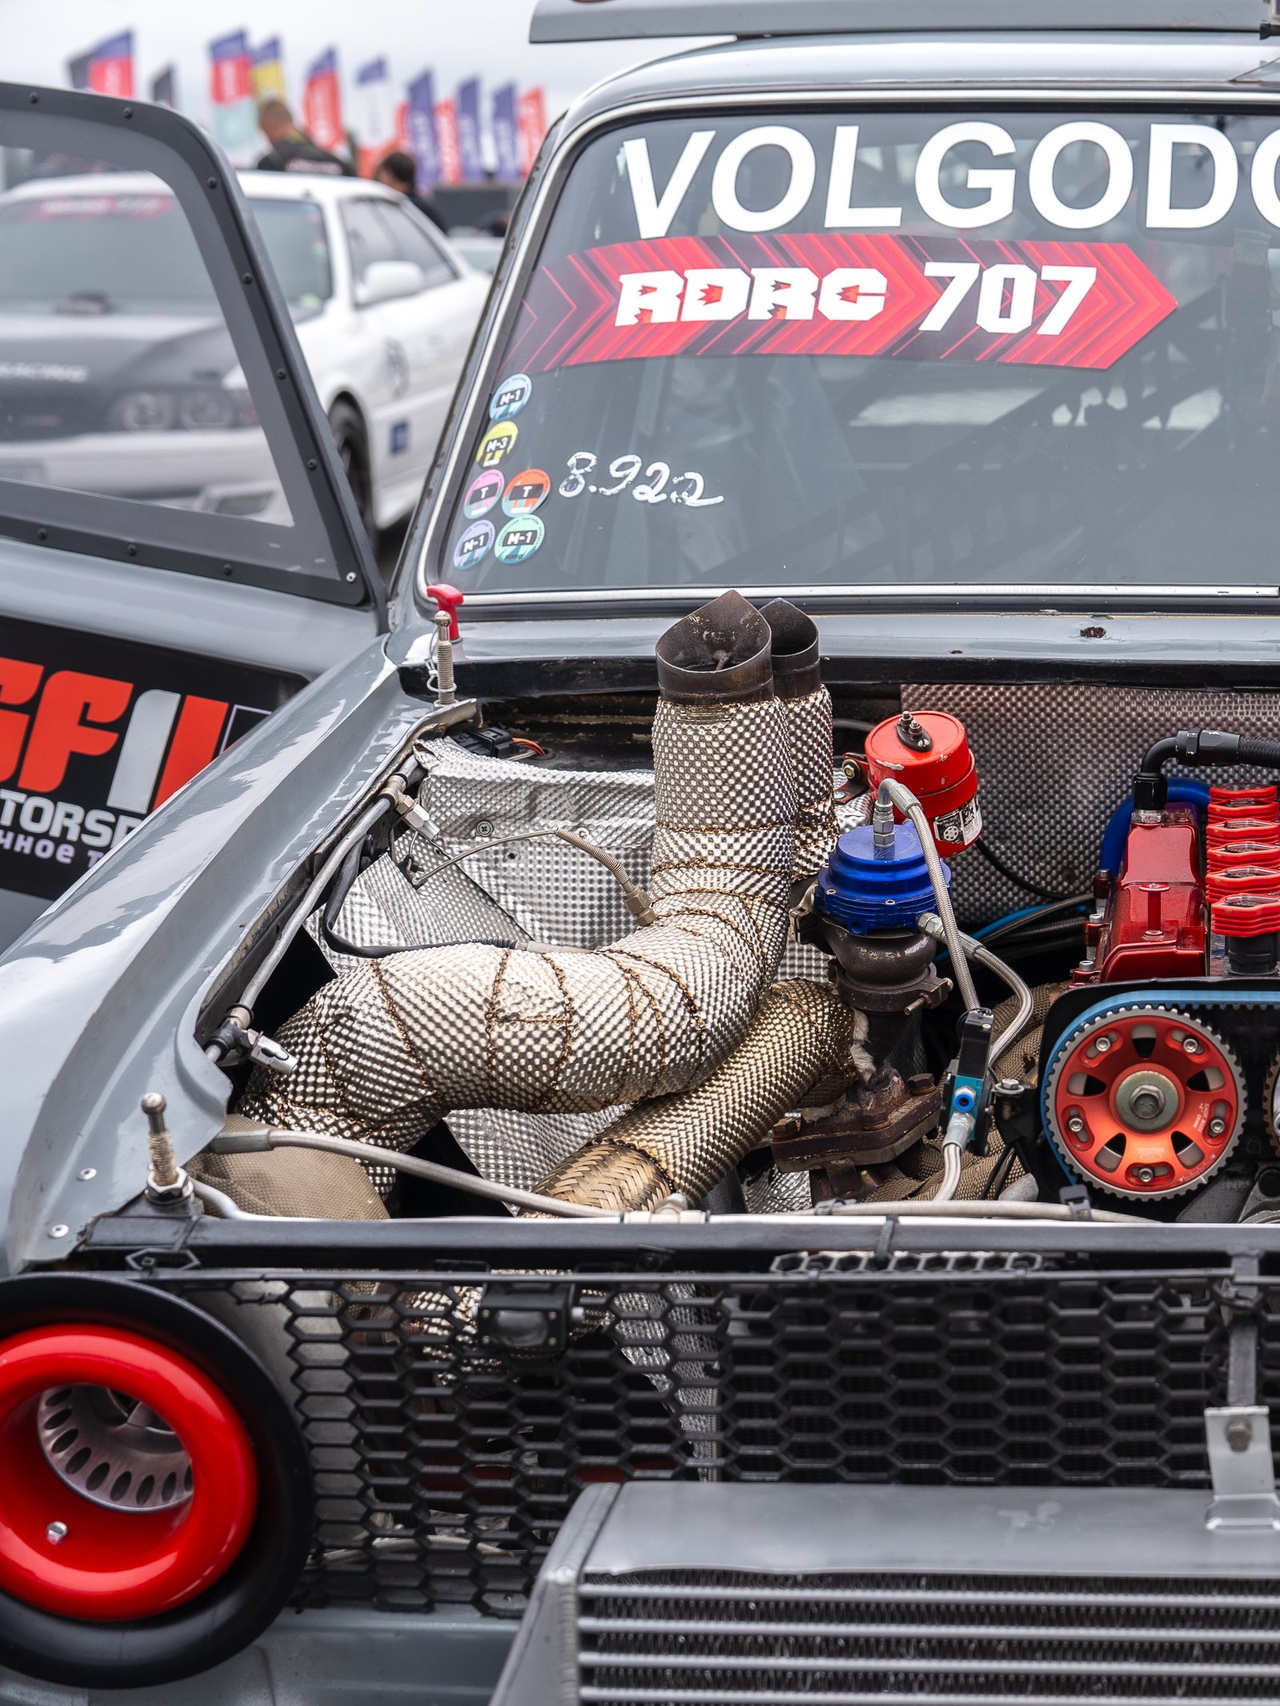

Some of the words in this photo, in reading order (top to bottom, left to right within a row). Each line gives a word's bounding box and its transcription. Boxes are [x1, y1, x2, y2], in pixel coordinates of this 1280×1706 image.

[615, 267, 888, 326] RDRC
[918, 261, 1097, 335] 707
[507, 531, 533, 545] M-1
